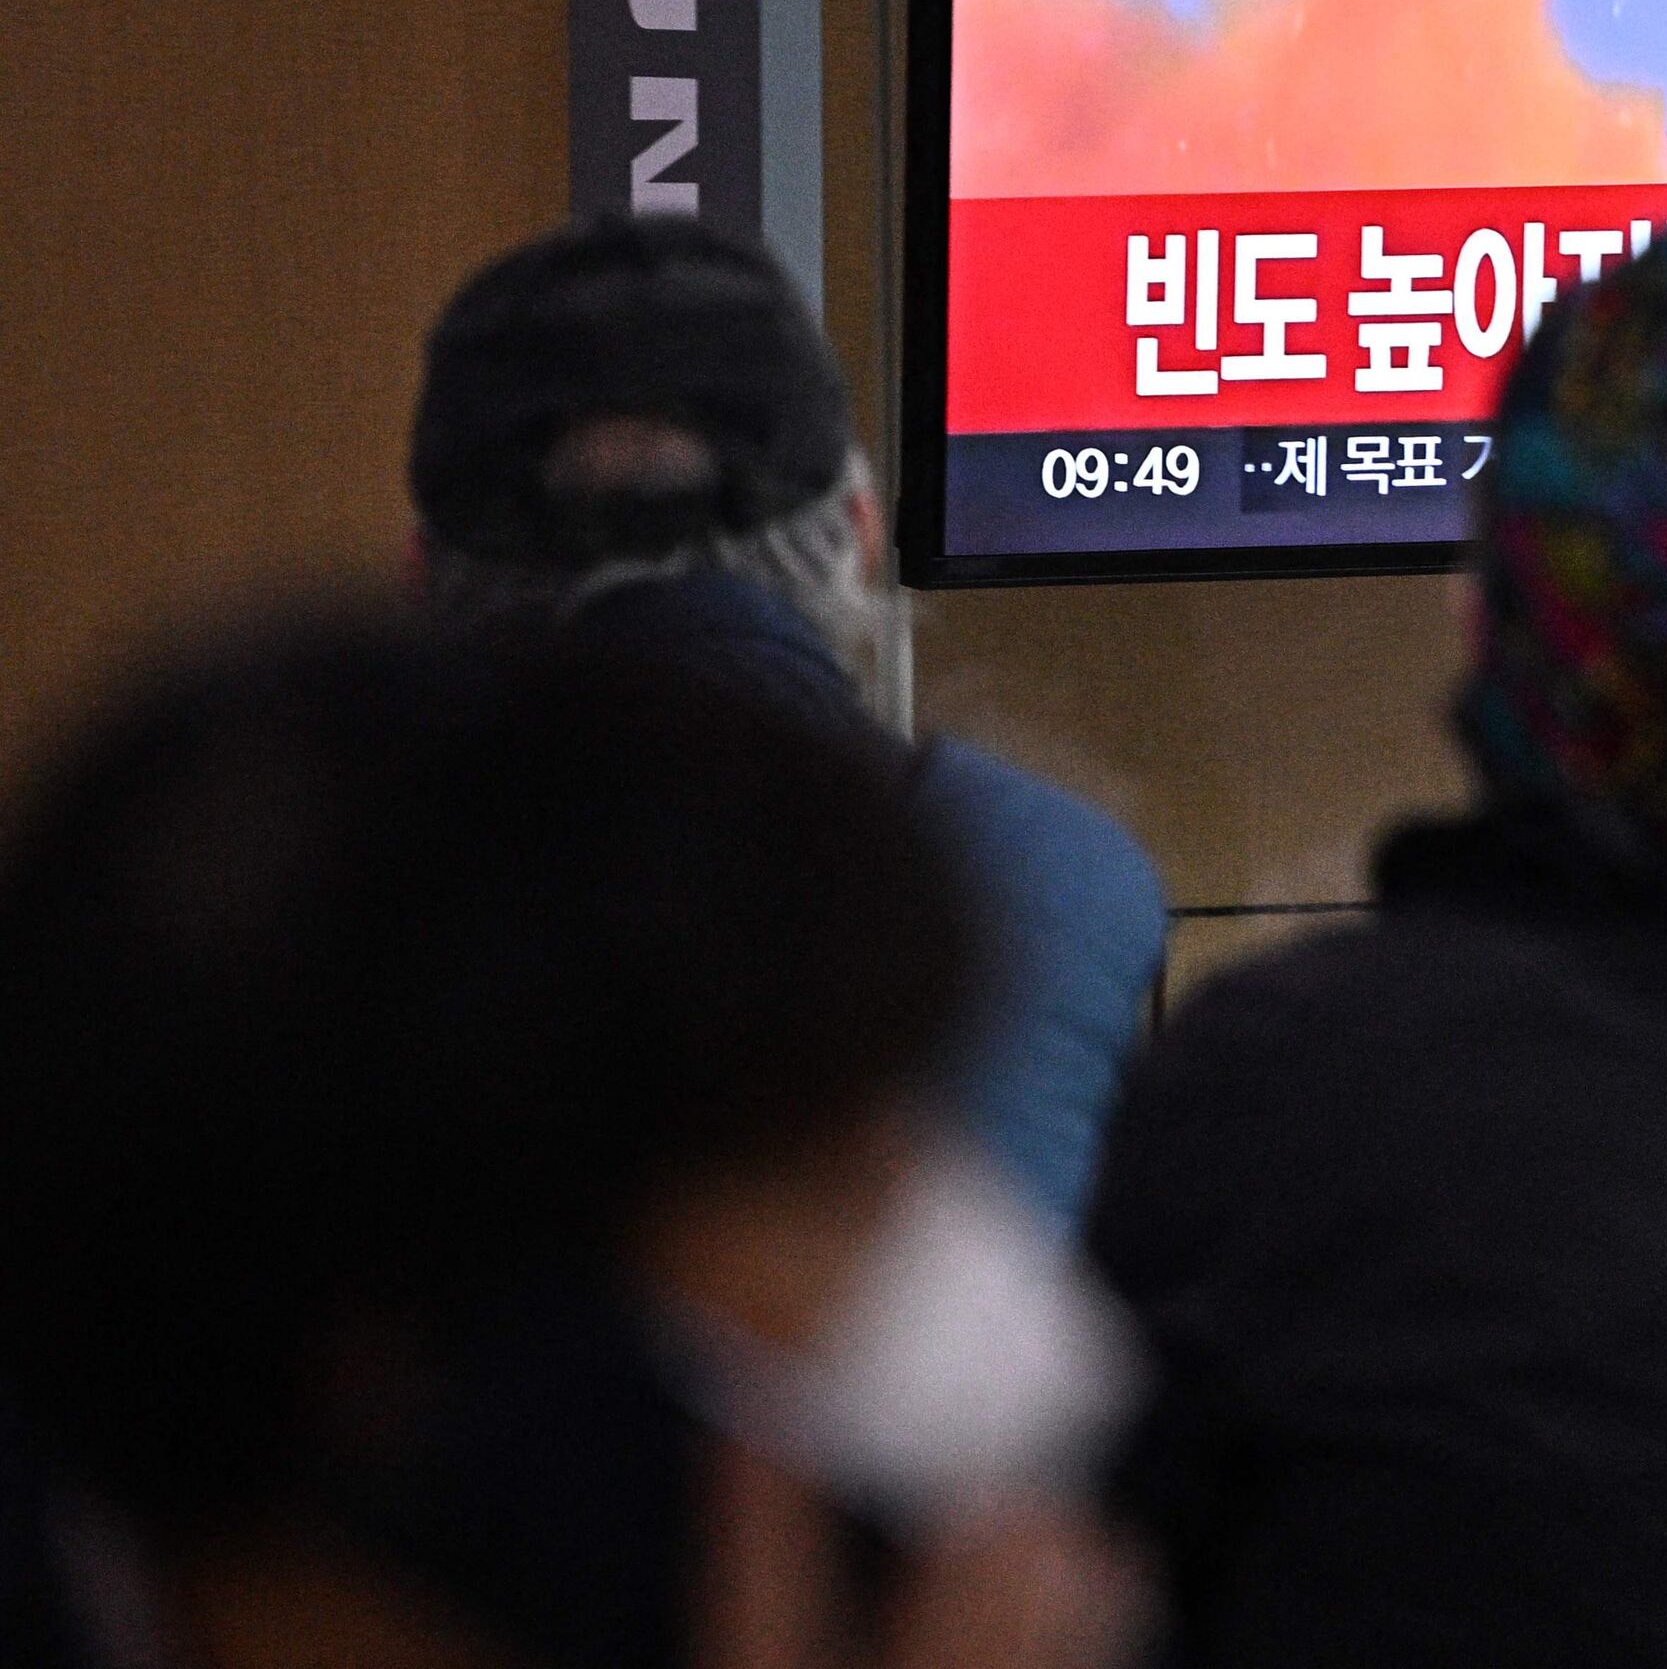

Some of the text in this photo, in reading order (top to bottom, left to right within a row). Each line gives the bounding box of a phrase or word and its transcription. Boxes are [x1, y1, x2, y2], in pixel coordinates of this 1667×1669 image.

[1125, 229, 1328, 397] 빈도
[1041, 445, 1201, 499] 09:49
[1340, 435, 1448, 496] 목표
